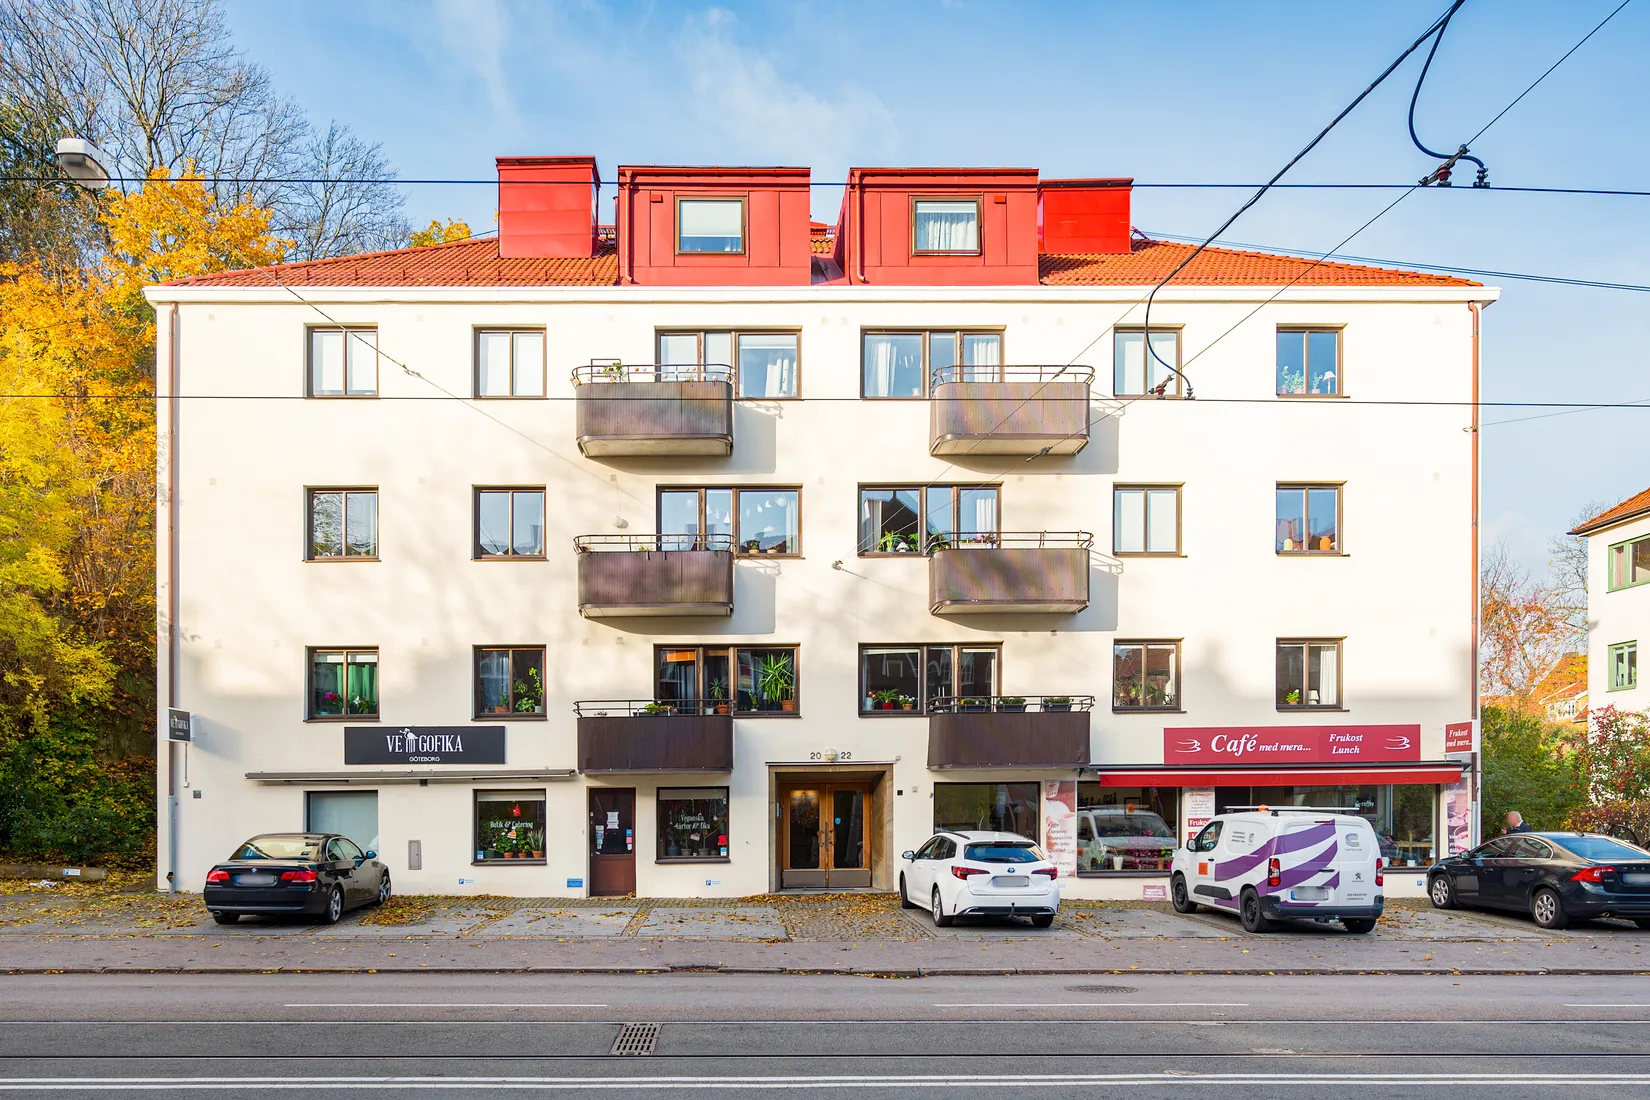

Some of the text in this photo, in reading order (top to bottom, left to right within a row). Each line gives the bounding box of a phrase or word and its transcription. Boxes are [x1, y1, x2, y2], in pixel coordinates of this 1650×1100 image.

[1449, 728, 1468, 737] Frukost
[1329, 733, 1363, 742] Frukost
[1211, 733, 1258, 756] Café
[1259, 742, 1278, 751] med
[1332, 745, 1360, 754] Lunch
[490, 820, 534, 829] Butik & Catering
